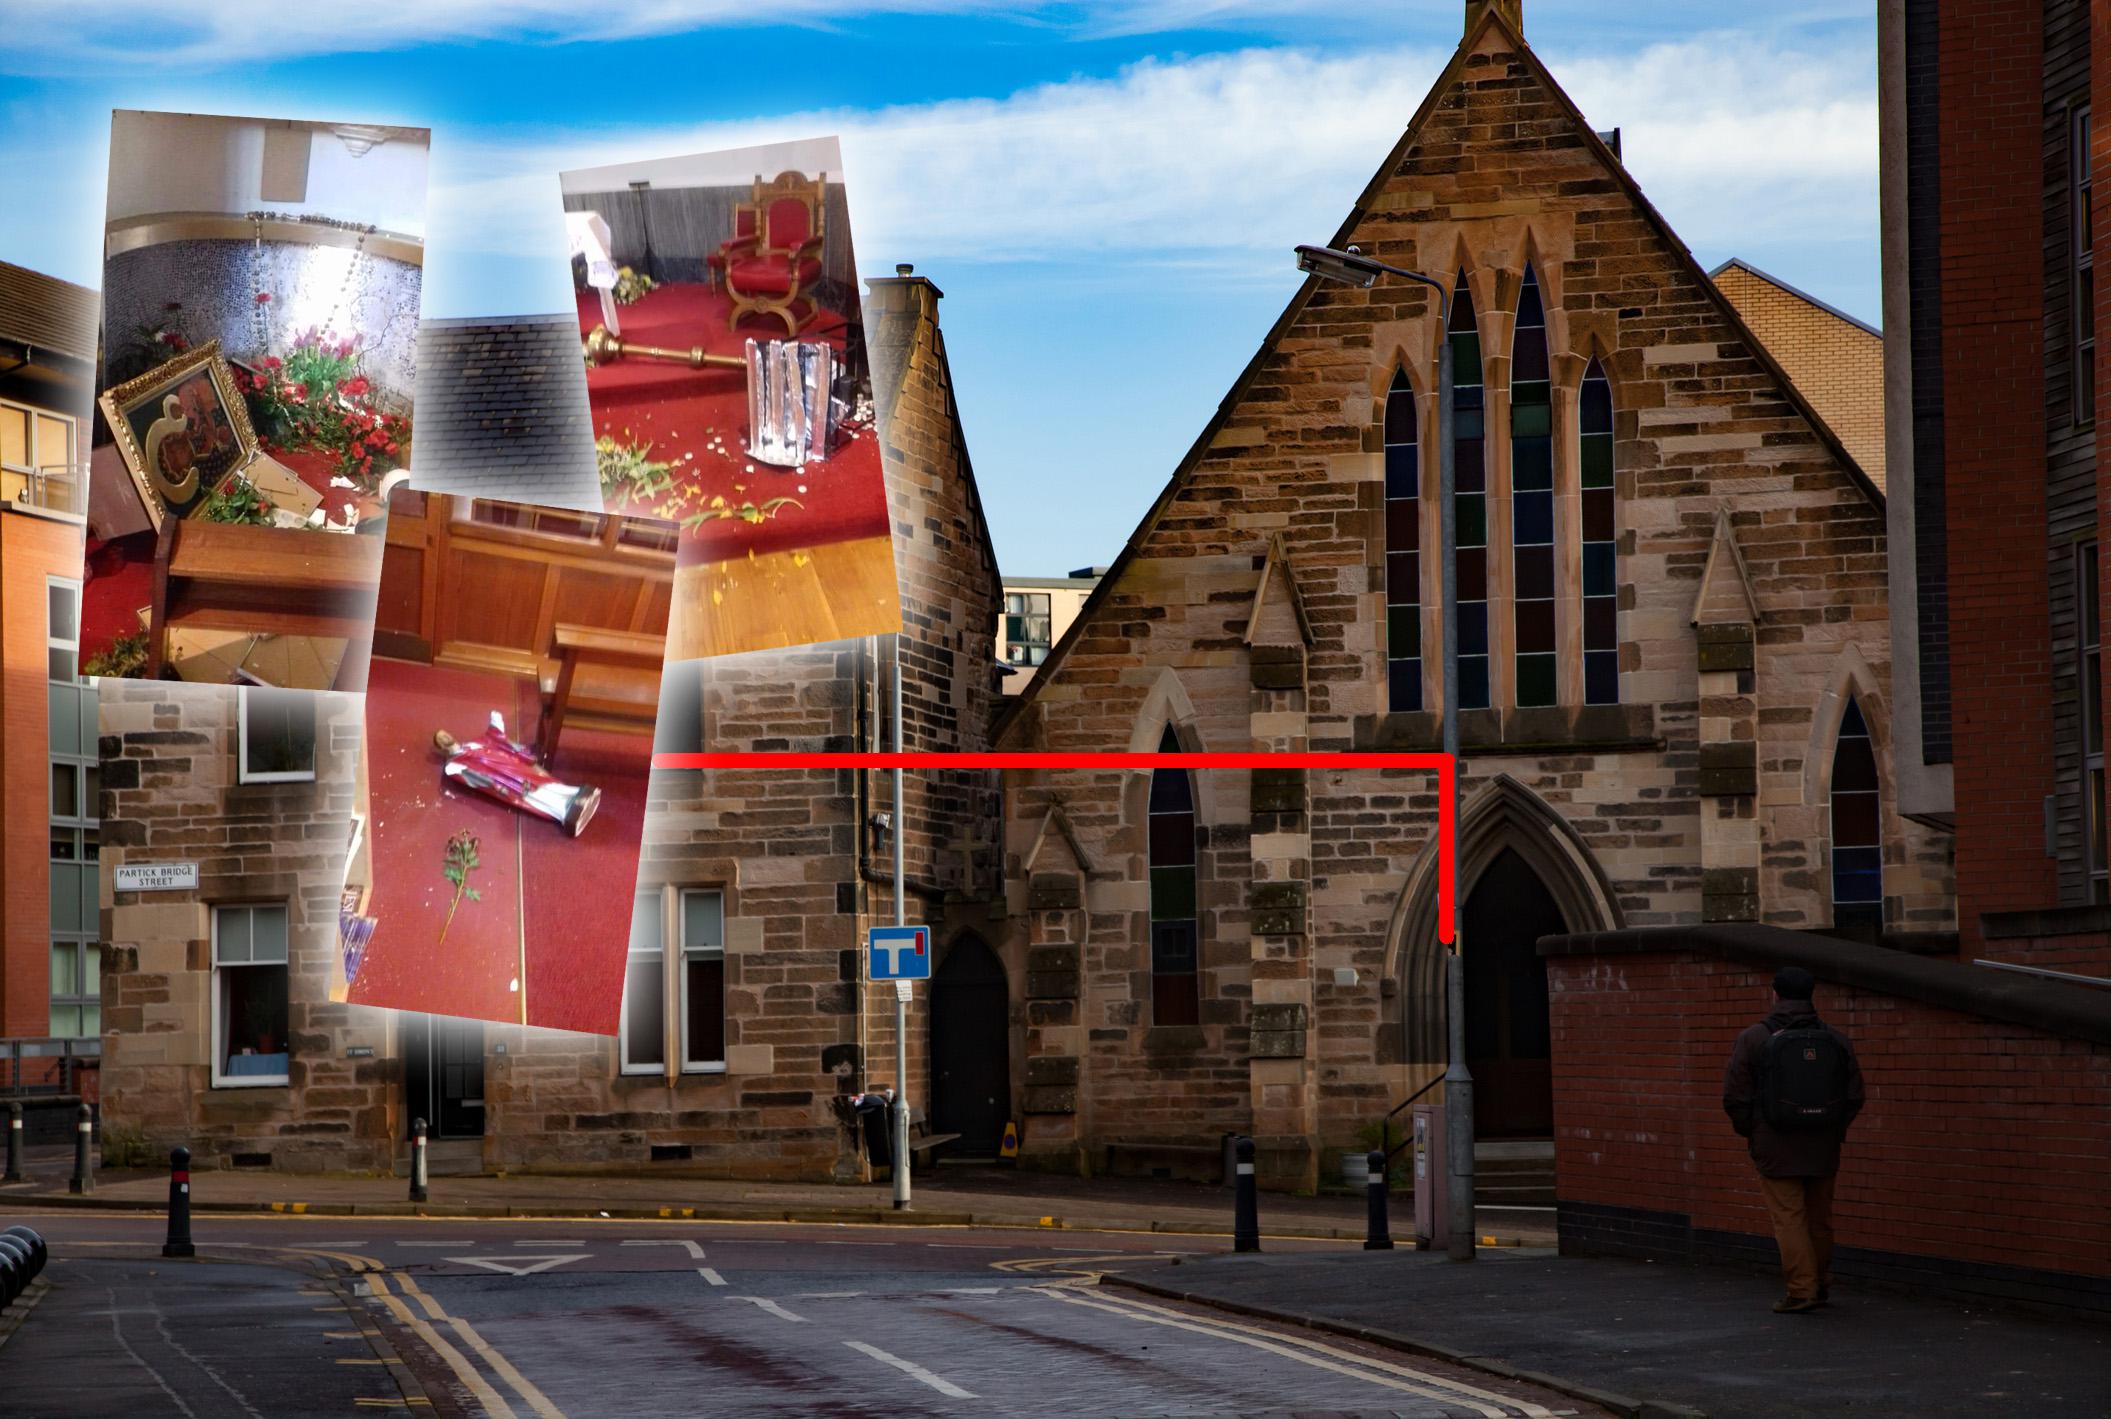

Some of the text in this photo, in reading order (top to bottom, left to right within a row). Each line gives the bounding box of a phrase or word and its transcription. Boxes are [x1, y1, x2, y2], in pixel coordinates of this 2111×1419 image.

[119, 866, 193, 878] PARTICK BRIDGE
[139, 877, 173, 886] STREET
